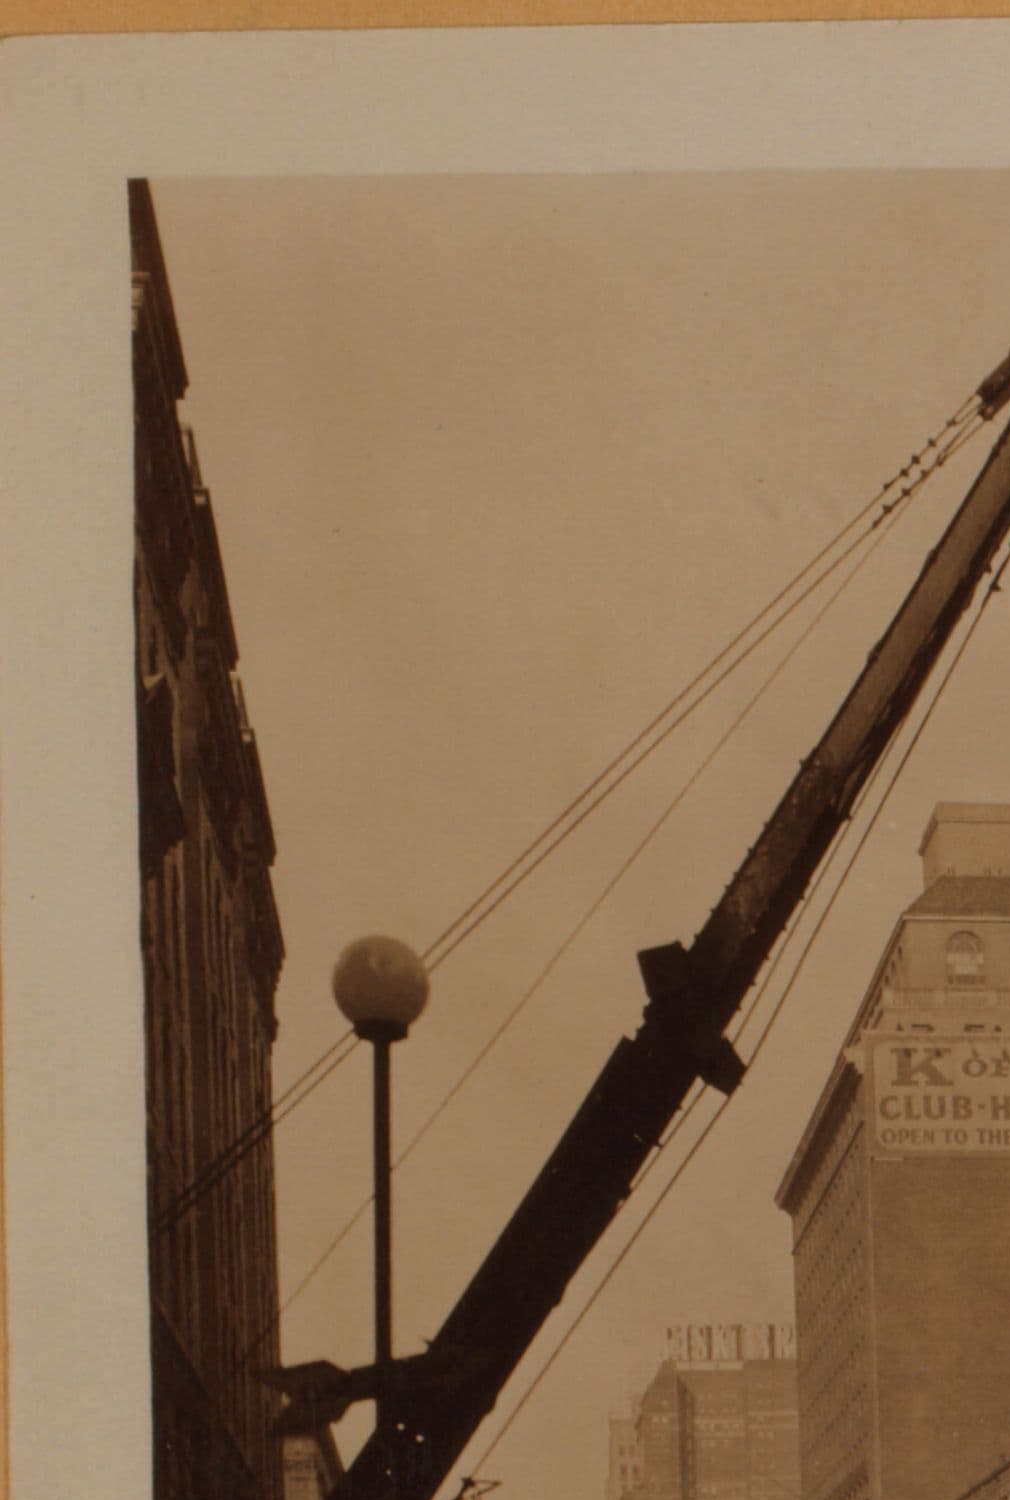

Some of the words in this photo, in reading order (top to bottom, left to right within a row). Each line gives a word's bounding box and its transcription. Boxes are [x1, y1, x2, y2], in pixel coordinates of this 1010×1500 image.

[891, 1048, 953, 1086] K
[881, 1128, 935, 1145] OPEN
[943, 1128, 968, 1145] TO
